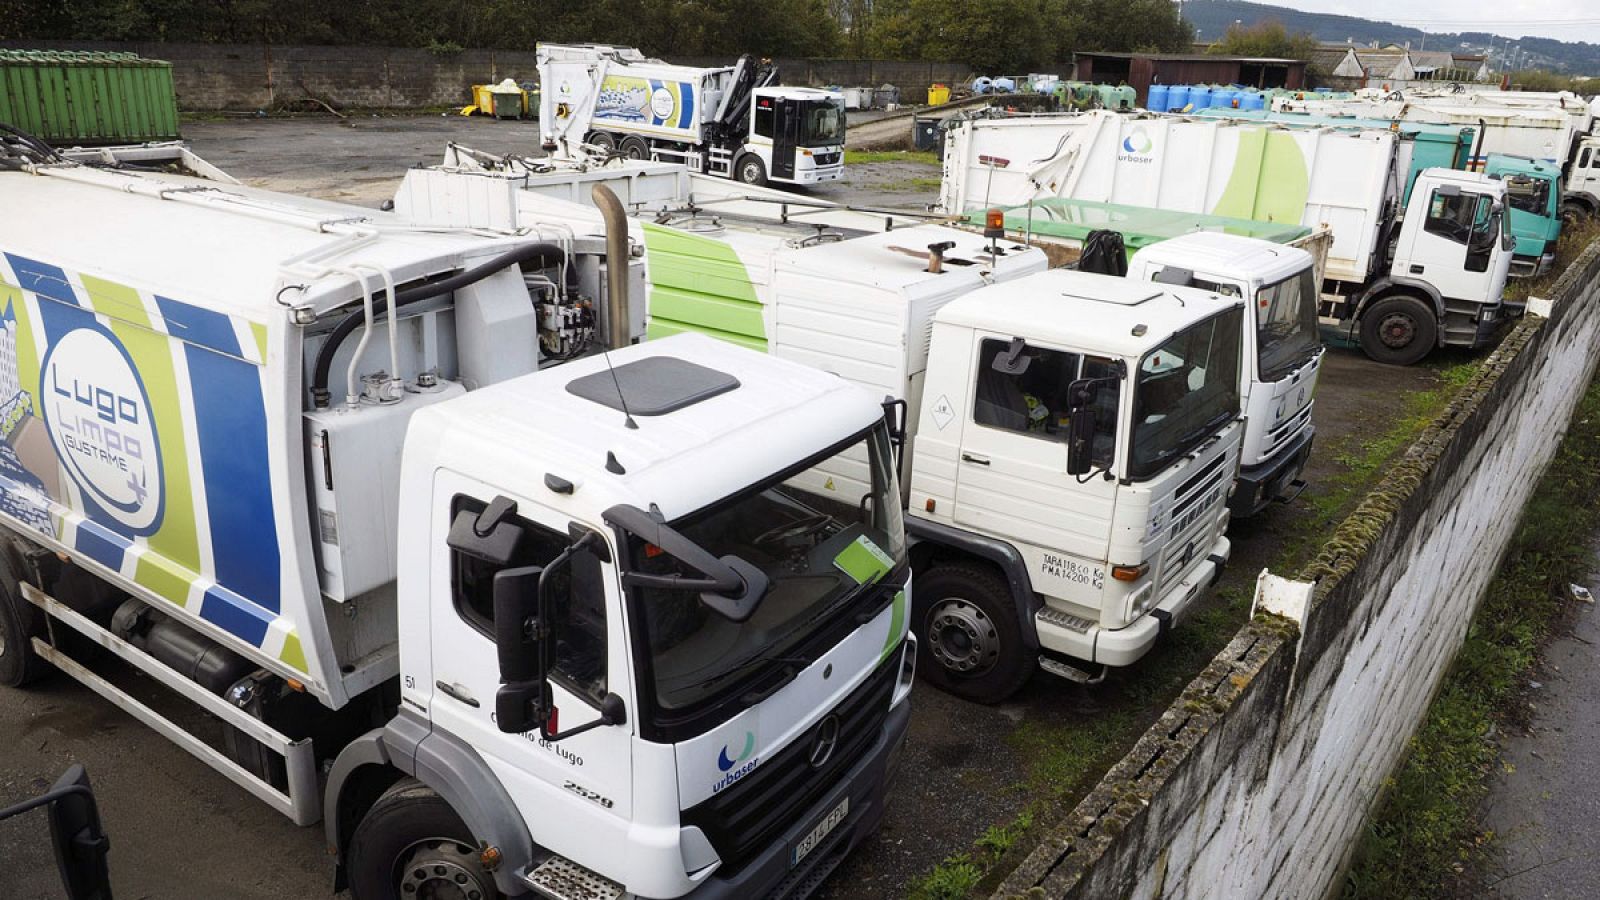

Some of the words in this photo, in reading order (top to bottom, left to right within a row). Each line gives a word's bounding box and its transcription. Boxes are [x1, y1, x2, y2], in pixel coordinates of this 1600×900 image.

[1118, 154, 1153, 164] urbaser
[53, 362, 139, 425] Lugo
[56, 401, 142, 461] Limpo
[404, 675, 416, 689] 51
[555, 744, 584, 766] Lugo
[712, 757, 760, 793] urbaser
